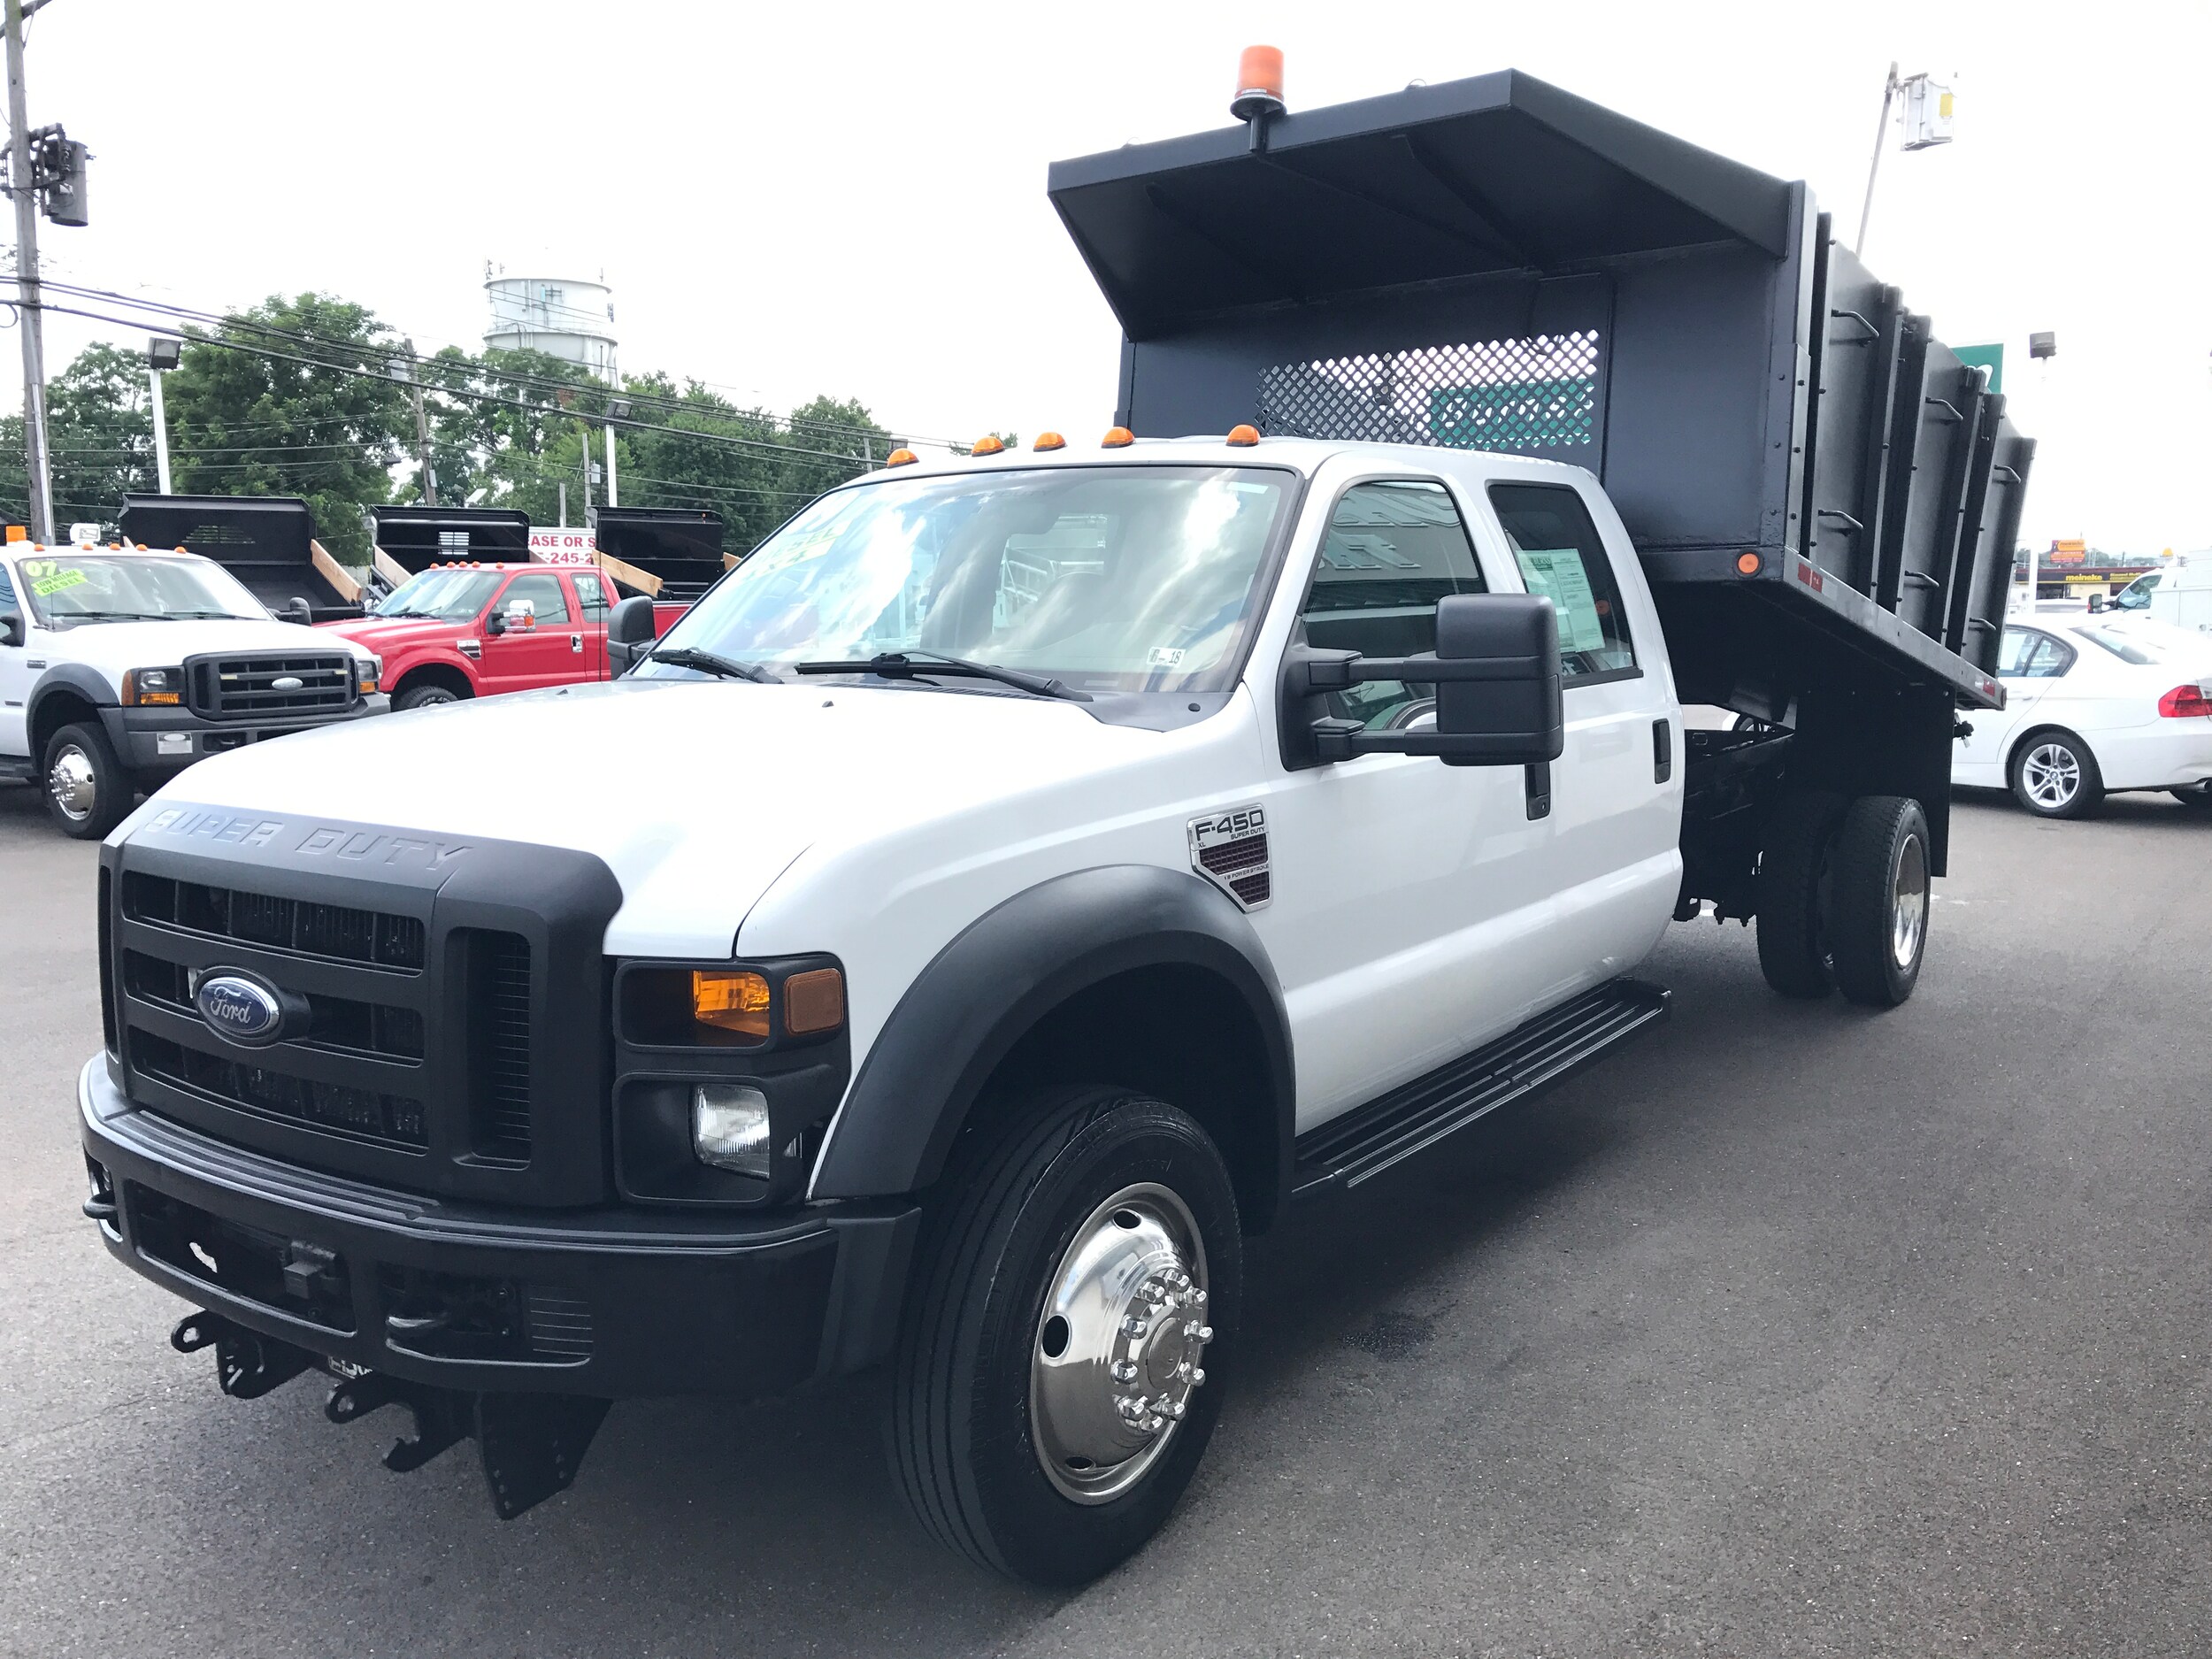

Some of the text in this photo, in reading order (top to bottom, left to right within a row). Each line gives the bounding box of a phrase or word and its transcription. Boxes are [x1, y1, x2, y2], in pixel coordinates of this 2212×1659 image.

[531, 535, 558, 547] ASE
[564, 536, 583, 547] OR
[26, 561, 57, 577] 07
[35, 579, 52, 588] LOW
[41, 577, 81, 594] DIESEL
[1195, 809, 1264, 841] F-450
[143, 808, 475, 872] SUPER DUTY
[1230, 830, 1249, 840] SUPER
[1232, 869, 1249, 879] POWER
[210, 986, 252, 1024] Ford
